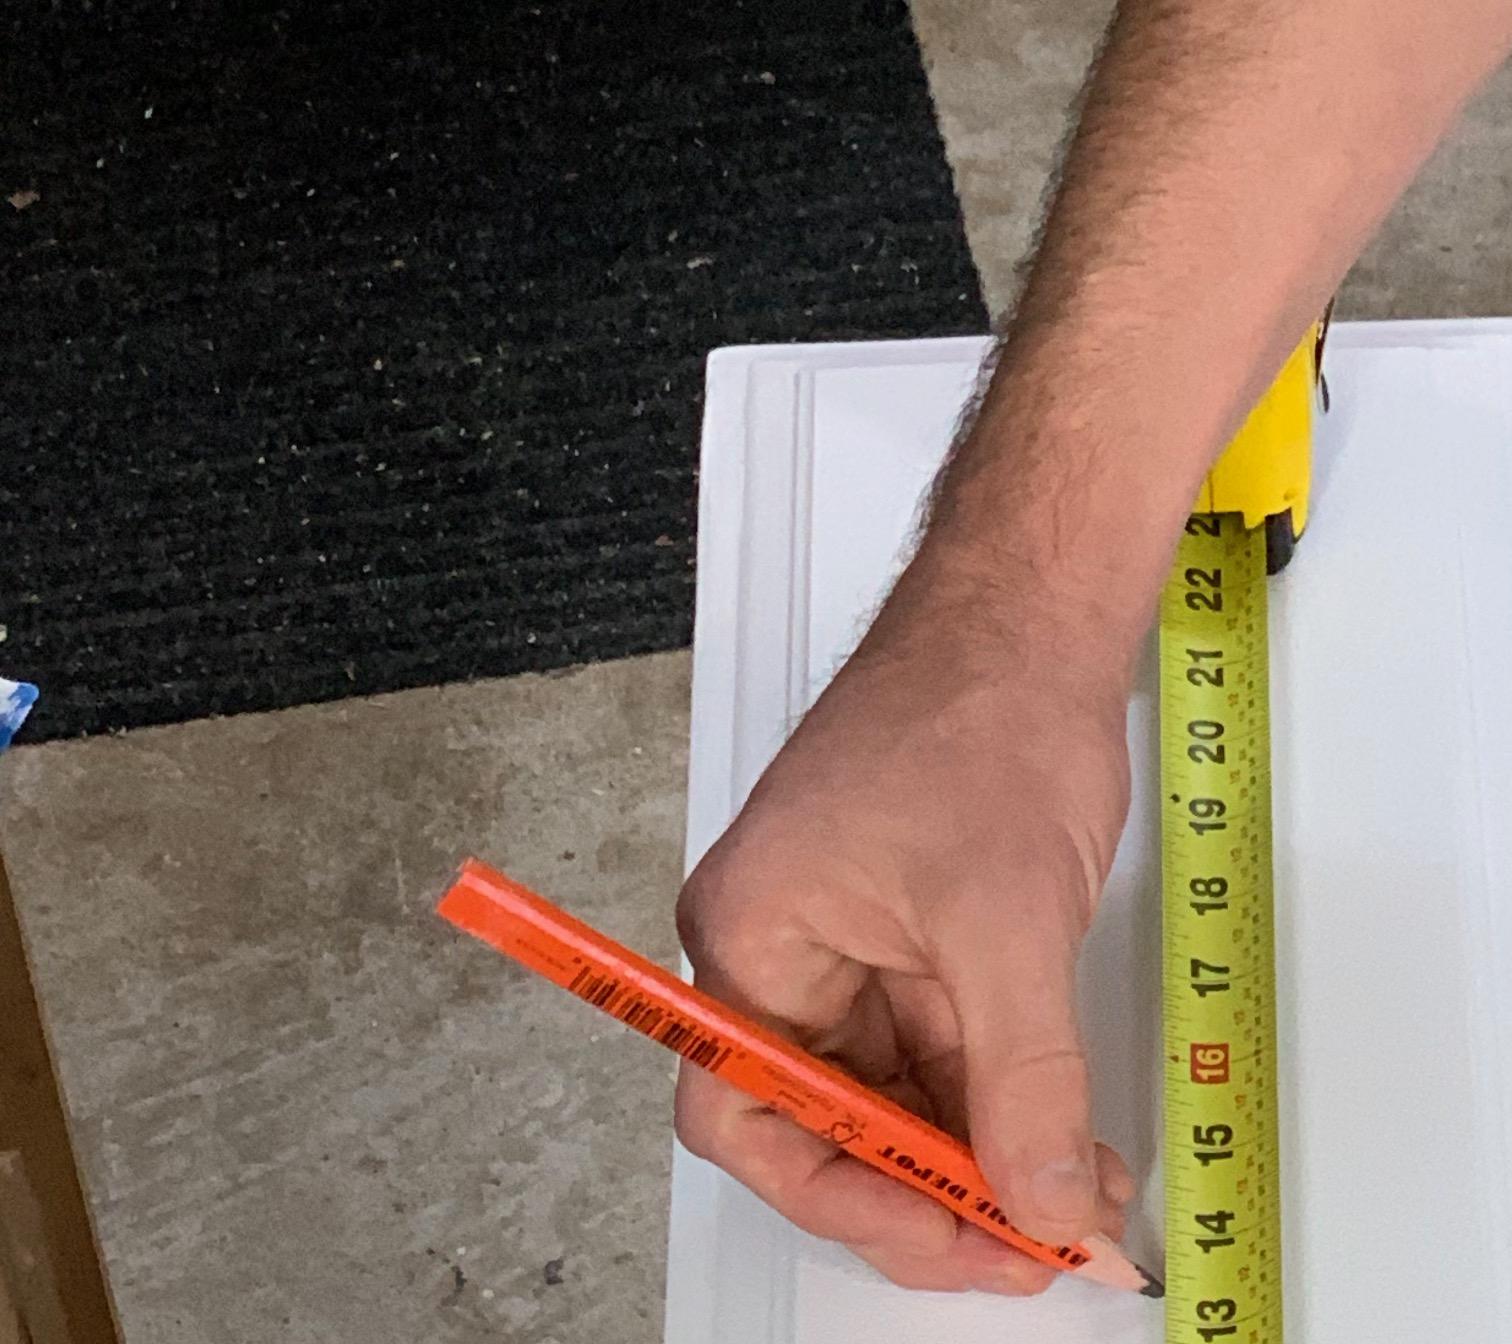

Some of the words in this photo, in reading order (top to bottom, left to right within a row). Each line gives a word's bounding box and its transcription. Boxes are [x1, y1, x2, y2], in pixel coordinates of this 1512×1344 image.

[1184, 512, 1221, 538] 2
[1184, 568, 1222, 612] 22
[1186, 648, 1224, 687] 21
[1187, 719, 1225, 764] 20
[1188, 798, 1227, 836] 19
[1189, 877, 1229, 916] 18
[1190, 958, 1230, 998] 17
[1198, 1049, 1225, 1081] 16
[1193, 1124, 1233, 1167] 15
[876, 1146, 968, 1201] DEPOT
[1194, 1210, 1235, 1254] 14
[1196, 1298, 1237, 1343] 13
